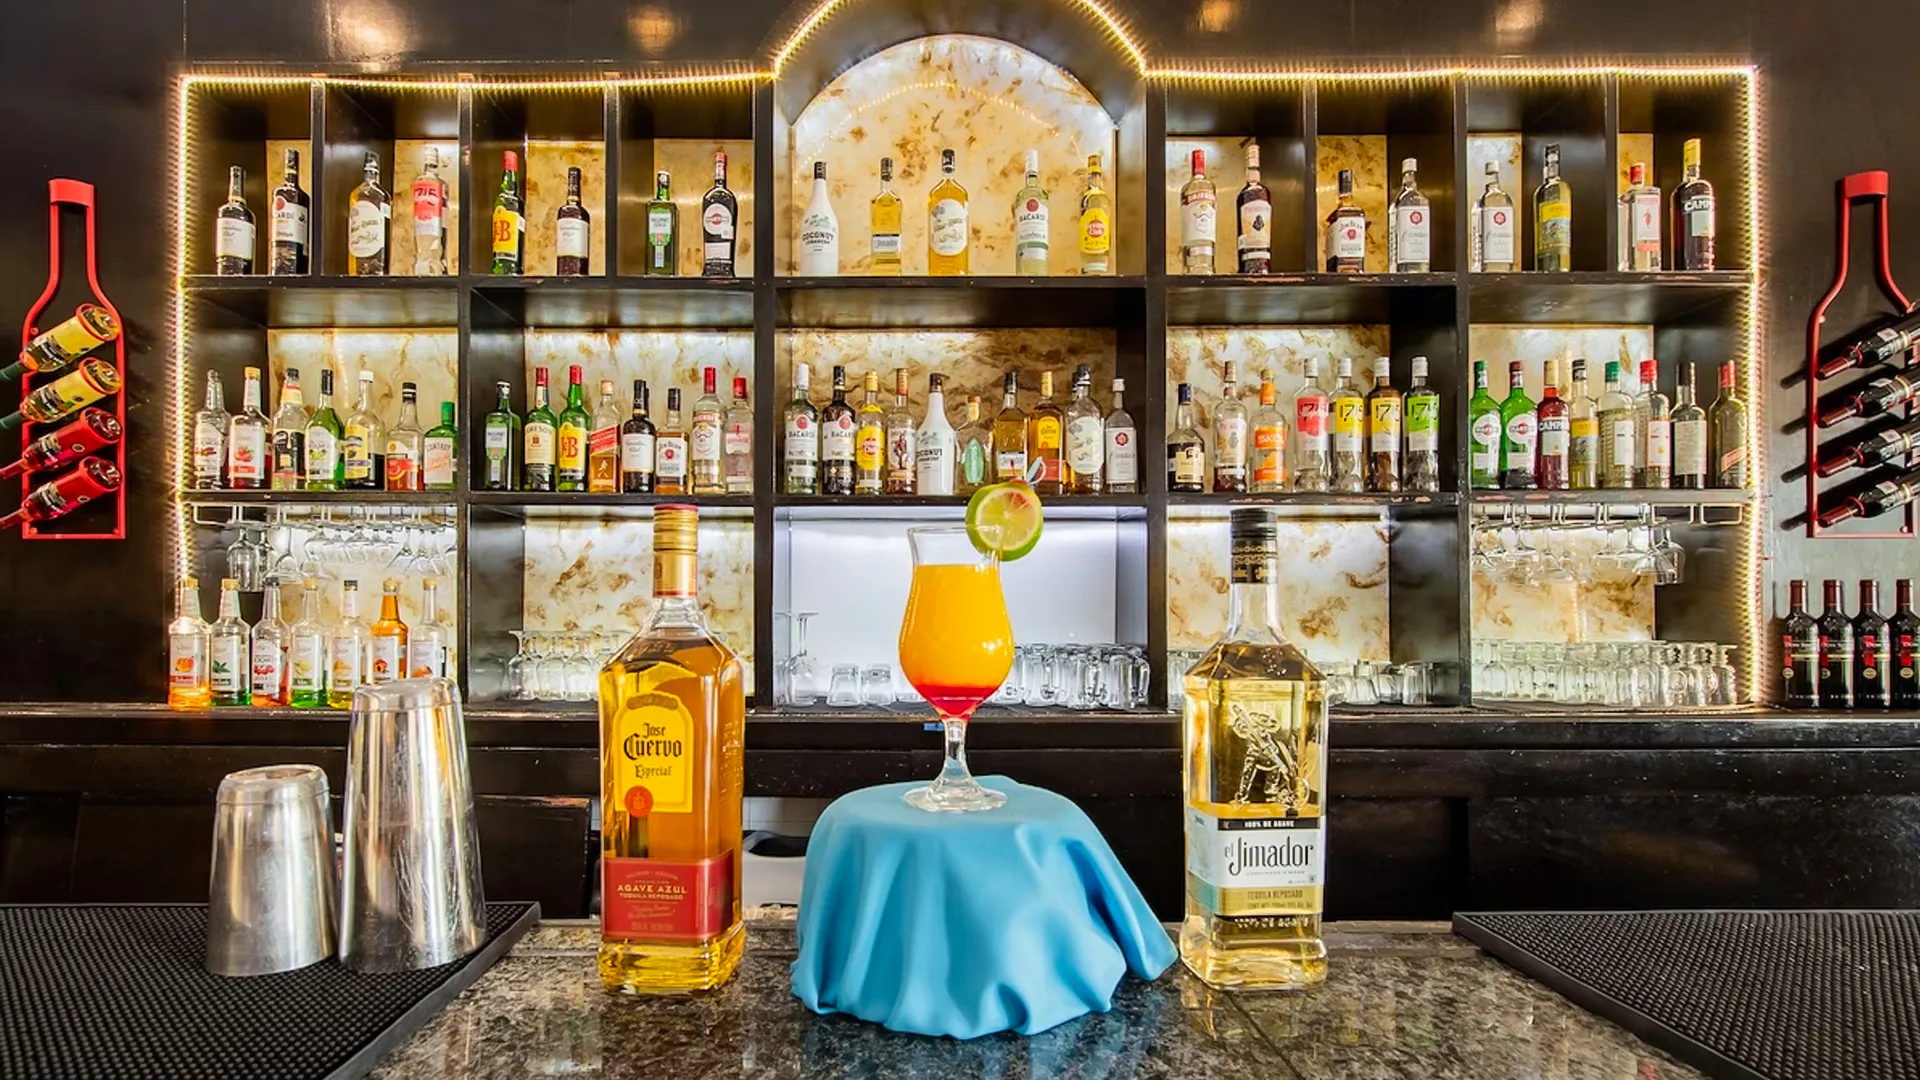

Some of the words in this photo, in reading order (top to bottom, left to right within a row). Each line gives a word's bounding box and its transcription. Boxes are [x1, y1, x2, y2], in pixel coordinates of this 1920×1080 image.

[642, 722, 666, 739] Jose
[623, 733, 682, 761] Cuervo
[634, 764, 672, 779] Especial
[1228, 835, 1314, 876] Jimador
[617, 884, 654, 893] AGAVE
[657, 885, 688, 894] AZUL
